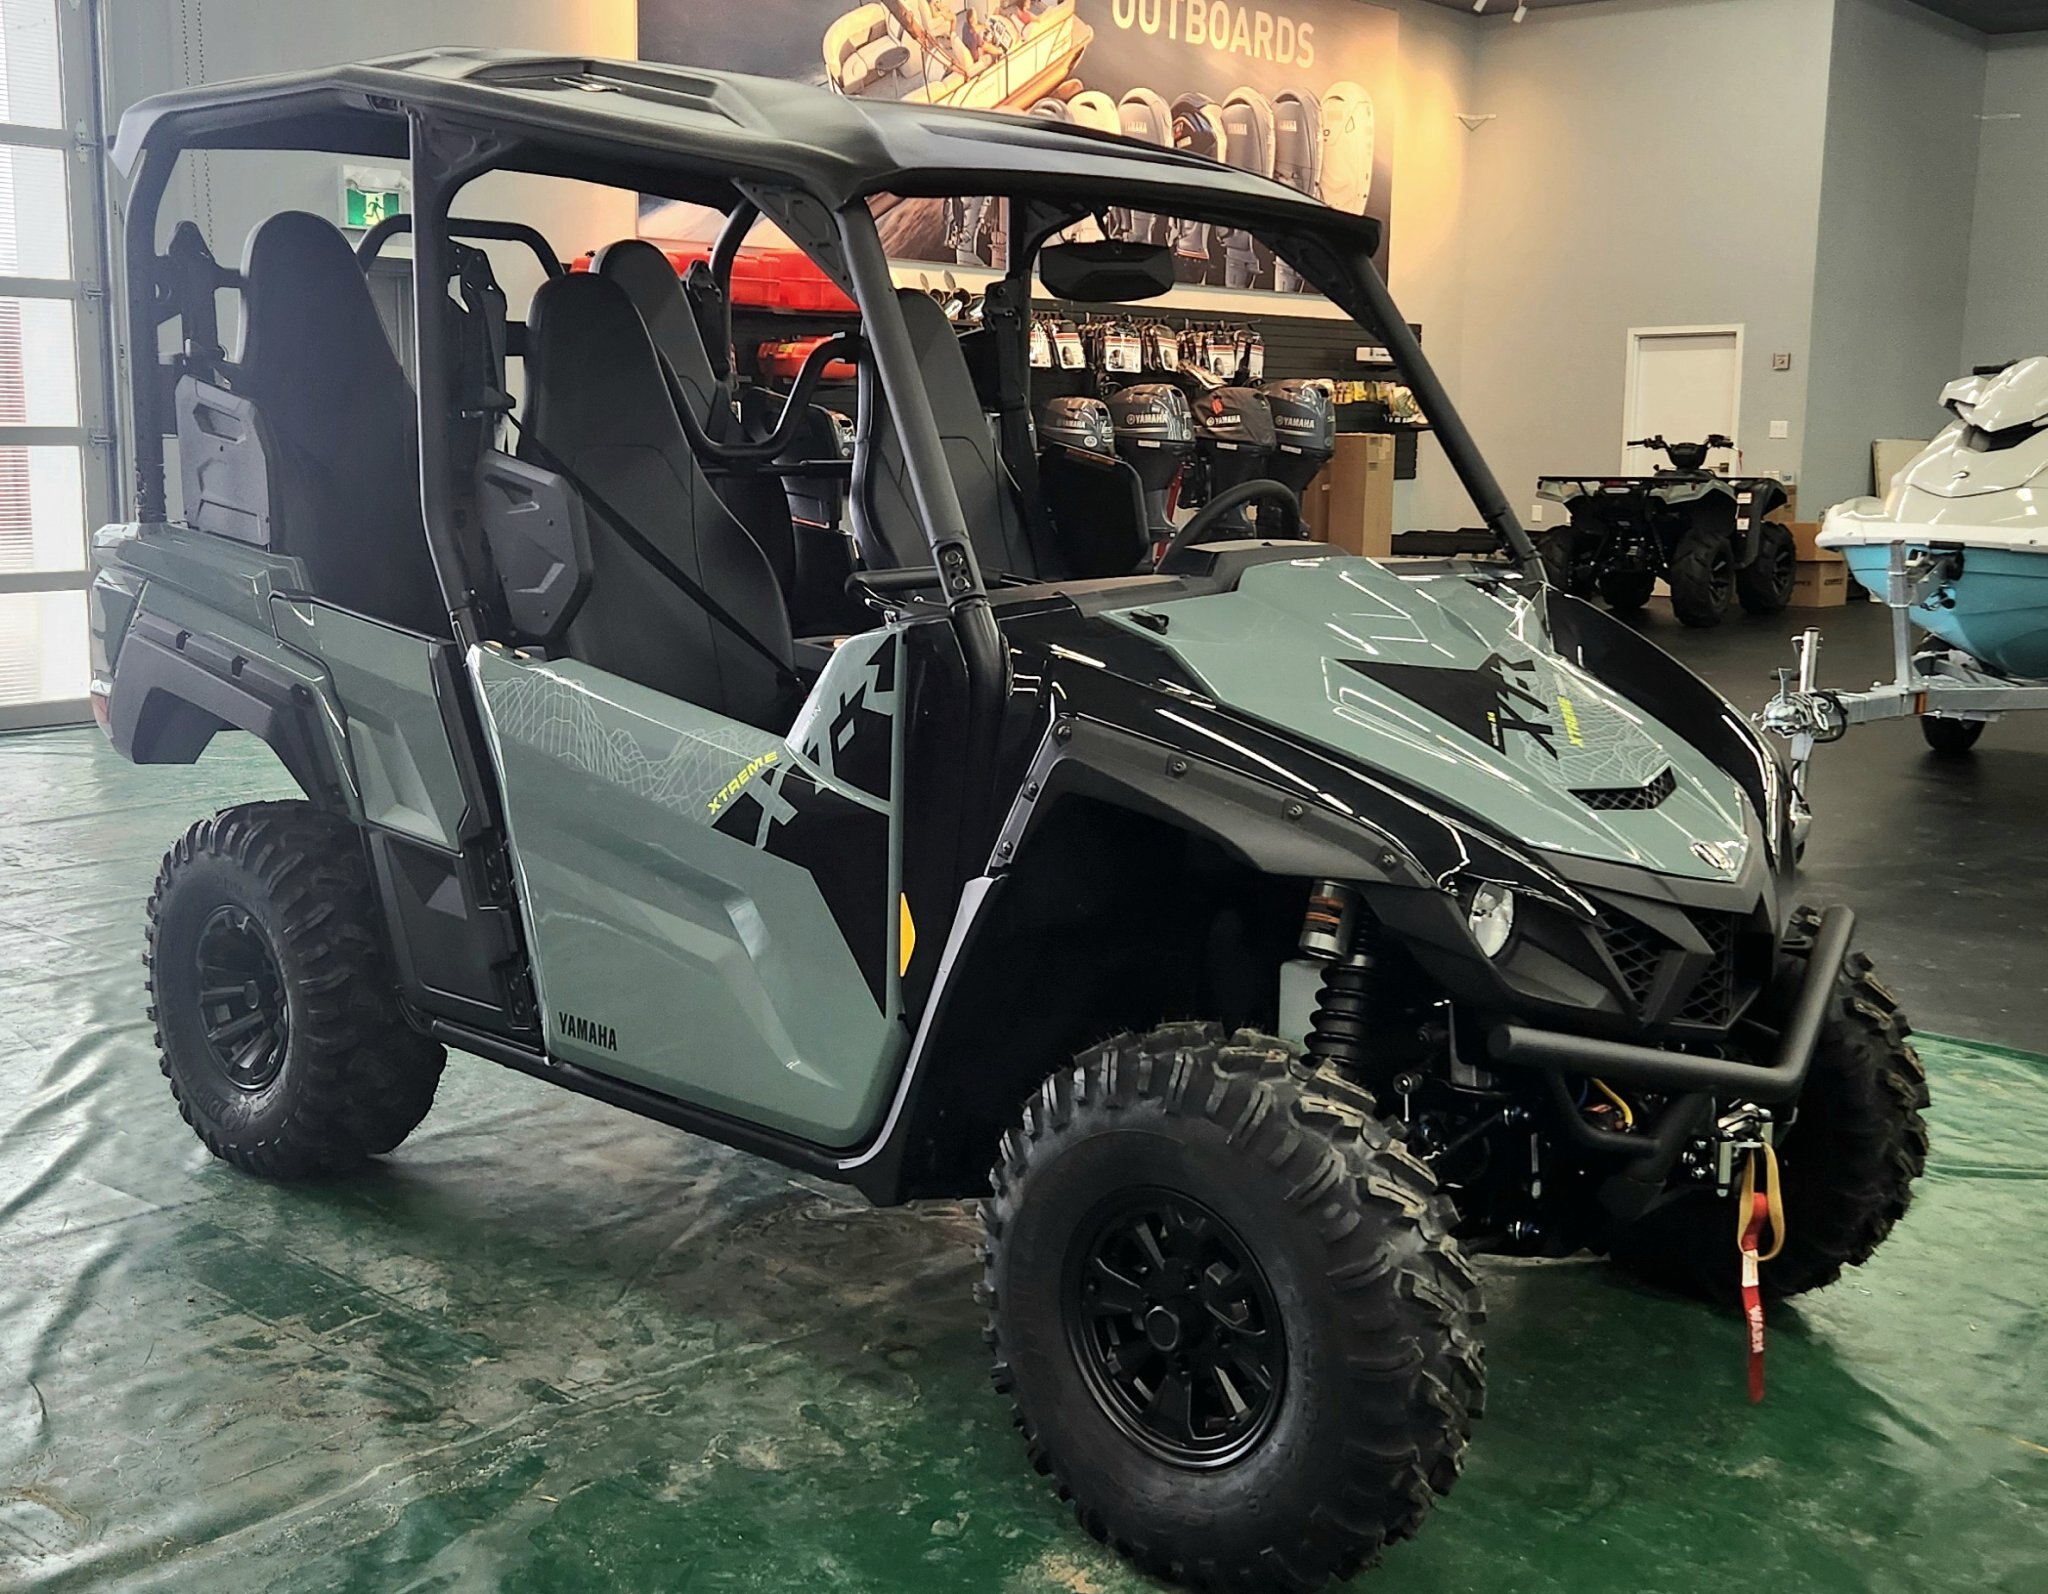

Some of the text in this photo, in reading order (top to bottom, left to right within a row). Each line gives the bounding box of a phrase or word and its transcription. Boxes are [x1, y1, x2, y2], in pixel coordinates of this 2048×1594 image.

[1112, 0, 1314, 69] OUTBOARDS
[1136, 412, 1169, 424] YAMAHA
[1215, 414, 1241, 425] YAMAHA
[1284, 416, 1315, 429] YAMAHA
[707, 751, 779, 815] XTREME
[558, 1011, 618, 1052] YAMAHA
